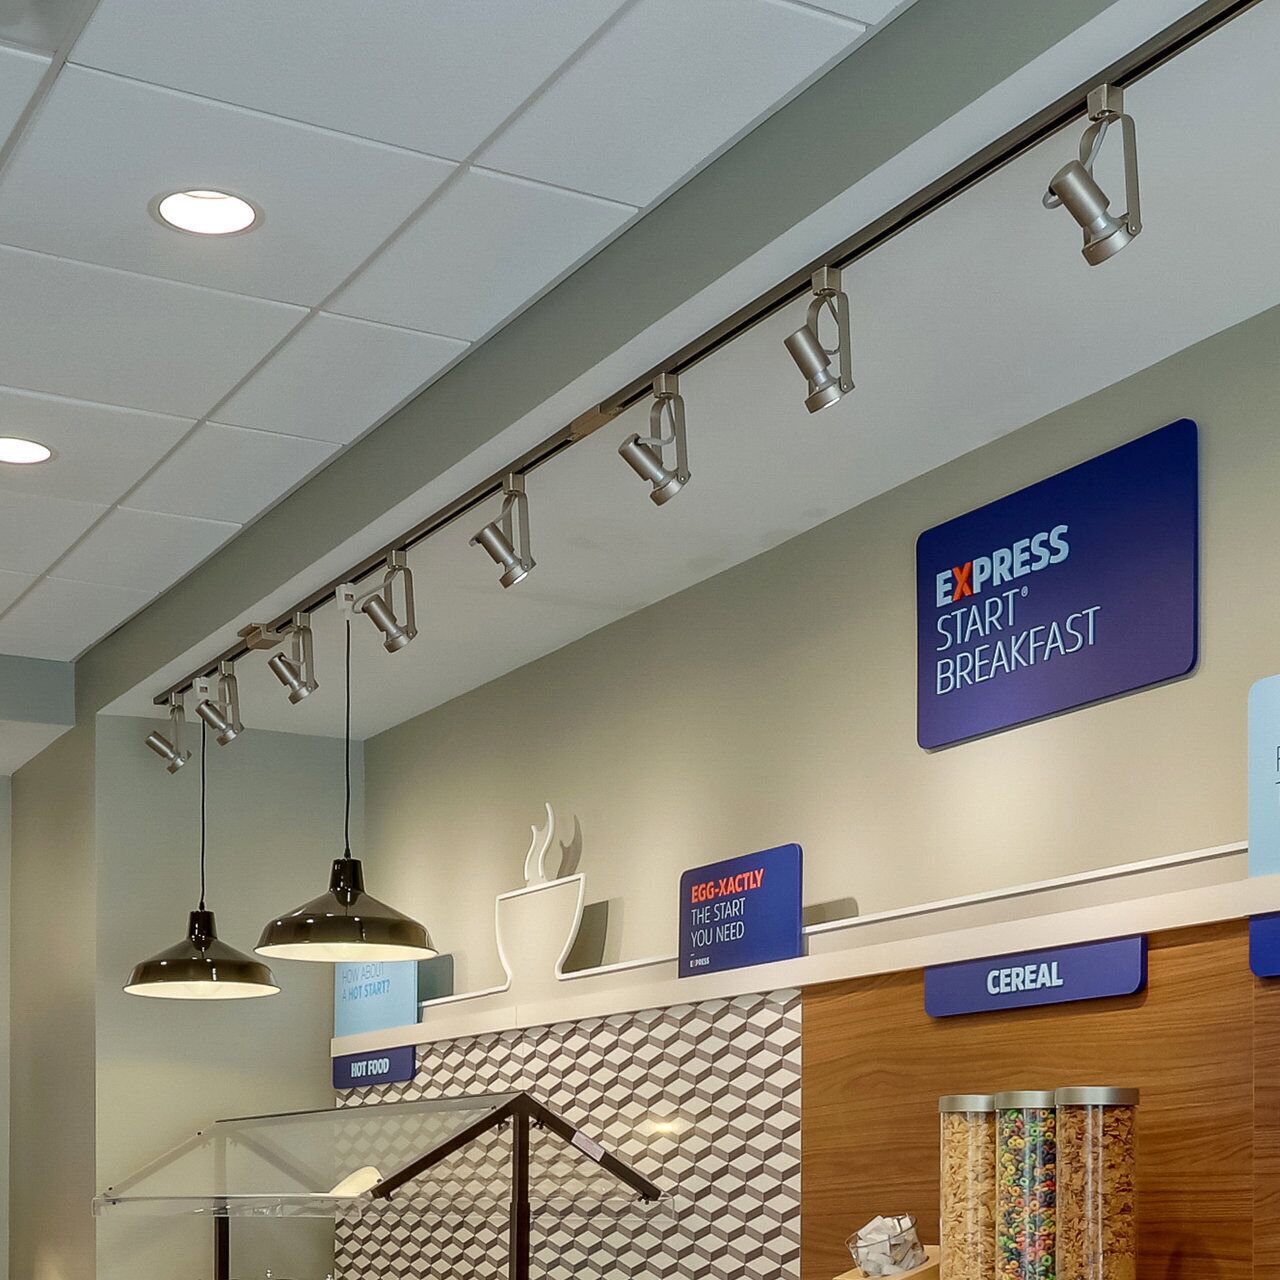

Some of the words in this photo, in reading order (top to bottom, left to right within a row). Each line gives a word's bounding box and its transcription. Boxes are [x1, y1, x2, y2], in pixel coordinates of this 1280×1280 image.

[936, 524, 1070, 608] EXPRESS
[936, 605, 1101, 695] BREAKFAST
[690, 868, 765, 904] EGG-XACTLY
[691, 905, 711, 926] THE
[713, 897, 746, 922] START
[690, 927, 713, 948] YOU
[715, 921, 745, 943] NEED
[342, 967, 360, 984] HOW
[342, 988, 347, 1000] A
[348, 985, 363, 1000] HOT
[364, 979, 391, 998] START?
[986, 961, 1064, 995] CEREAL
[351, 1060, 367, 1078] HOT
[367, 1057, 390, 1076] FOOD
